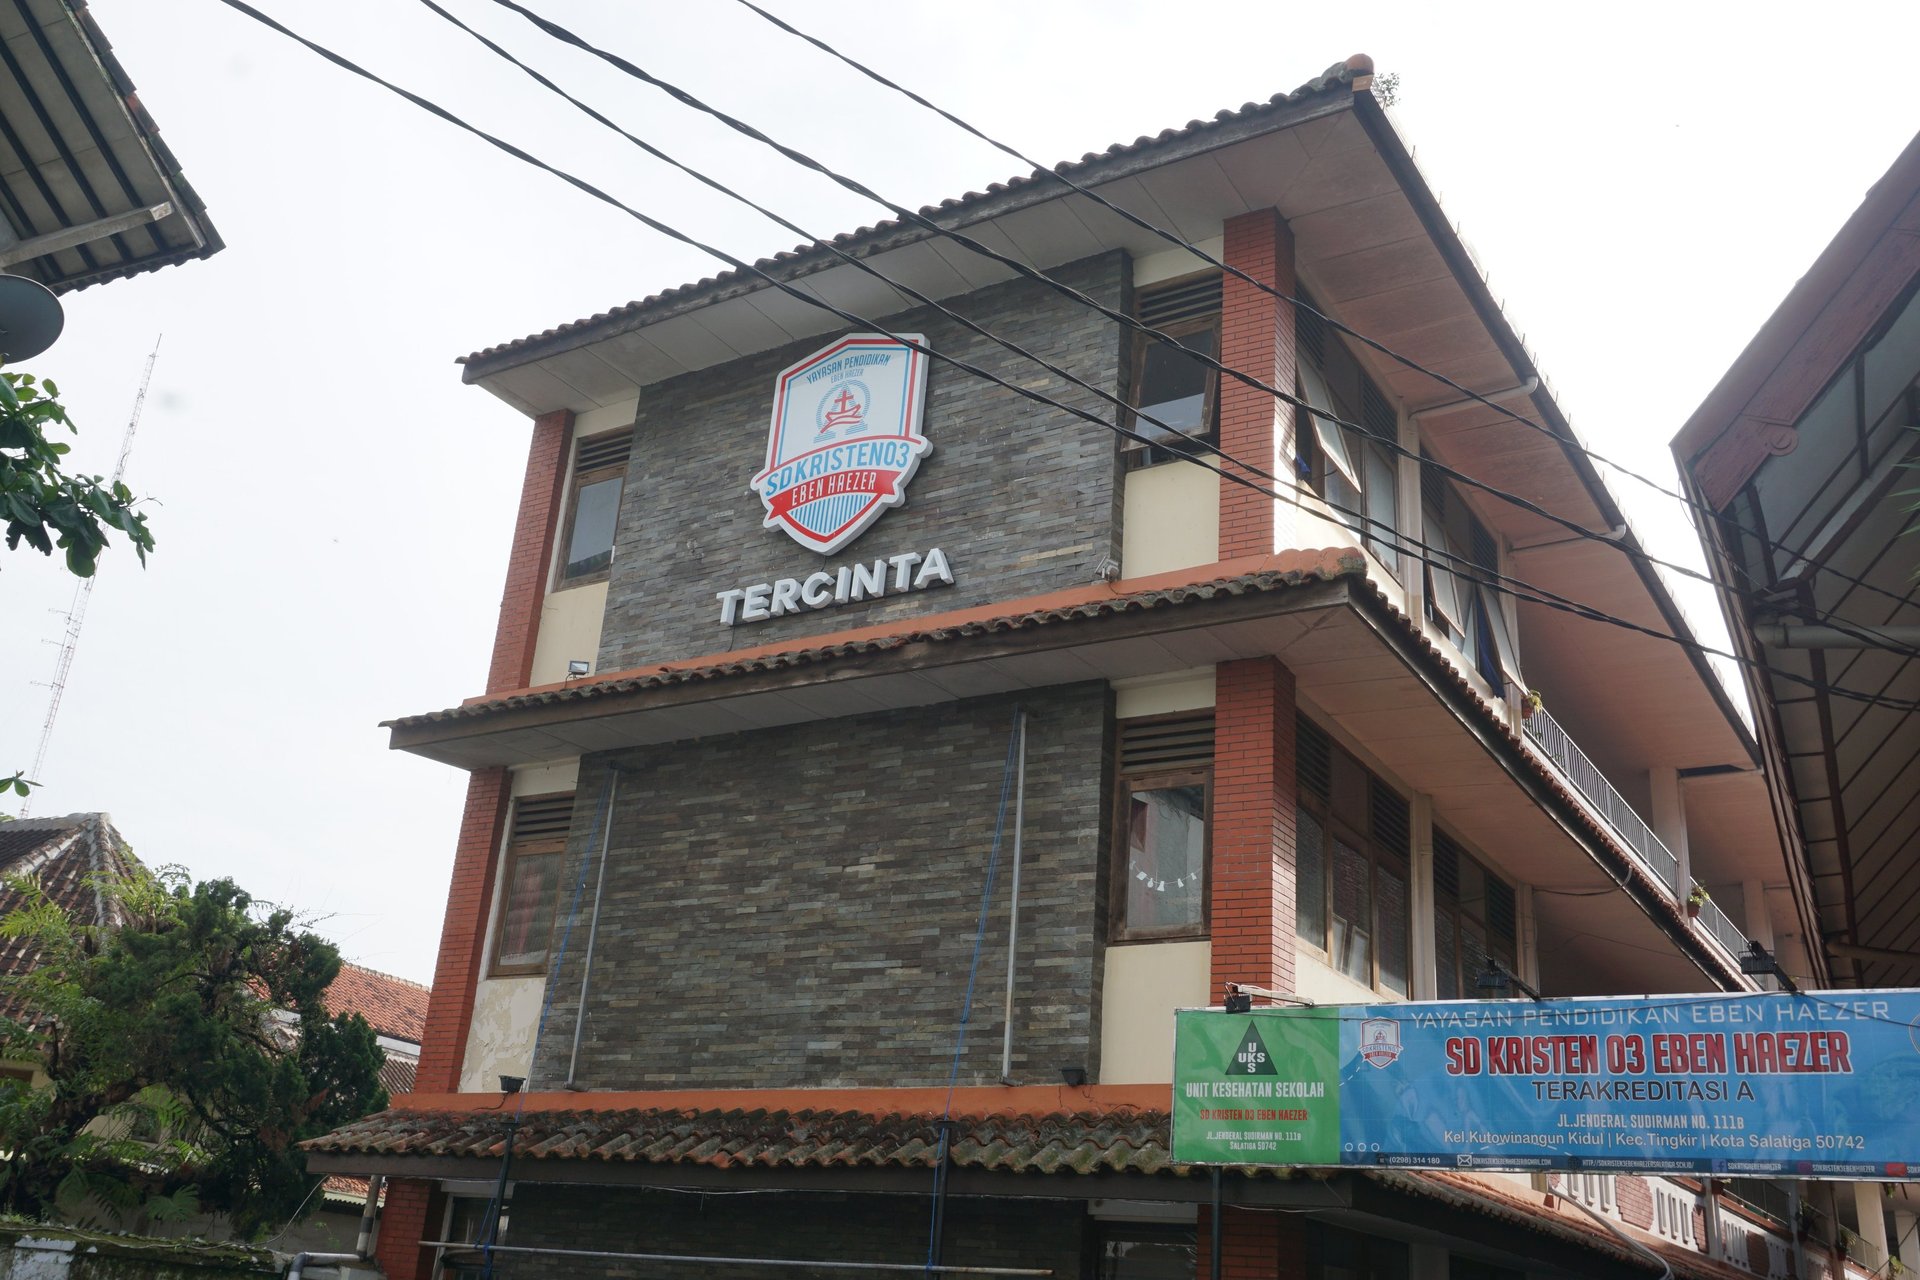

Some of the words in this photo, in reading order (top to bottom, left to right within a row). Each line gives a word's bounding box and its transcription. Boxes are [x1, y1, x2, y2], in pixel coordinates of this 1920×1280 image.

[806, 360, 843, 384] YAYASAN
[844, 353, 892, 370] PENDIDIKAN
[830, 373, 845, 384] EBEN
[791, 478, 824, 507] EBEN
[827, 471, 877, 495] HAEZER
[716, 547, 955, 626] TERCINTA
[1412, 1009, 1512, 1028] YAYASAN
[1523, 1005, 1679, 1026] PENDIDIKAN
[1693, 1004, 1763, 1023] EBEN
[1777, 1001, 1889, 1021] HAEZER
[1238, 1052, 1266, 1063] UKS
[1446, 1036, 1482, 1076] SD
[1487, 1034, 1600, 1076] KRISTEN
[1605, 1033, 1647, 1075] 03
[1652, 1032, 1728, 1075] EBEN
[1732, 1030, 1853, 1075] HAEZER
[1186, 1082, 1210, 1098] UNIT
[1212, 1082, 1272, 1098] KESEHATAN
[1275, 1082, 1325, 1098] SEKOLAH
[1532, 1080, 1729, 1101] TERAKREDITASI
[1737, 1080, 1756, 1101] A
[1200, 1109, 1210, 1120] SD
[1212, 1109, 1243, 1120] KRISTEN
[1245, 1109, 1255, 1120] 03
[1257, 1109, 1276, 1120] EBEN
[1279, 1109, 1308, 1121] HAEZER
[1630, 1115, 1688, 1129] SUDIRMAN
[1691, 1115, 1710, 1129] NO.
[1243, 1132, 1273, 1140] SUDIRMAN
[1568, 1132, 1604, 1145] Kidul
[1710, 1134, 1745, 1148] Kota
[1749, 1135, 1811, 1151] Salatiga
[1816, 1135, 1865, 1149] 50742
[1257, 1141, 1277, 1150] 50742
[1427, 1157, 1440, 1165] 180
